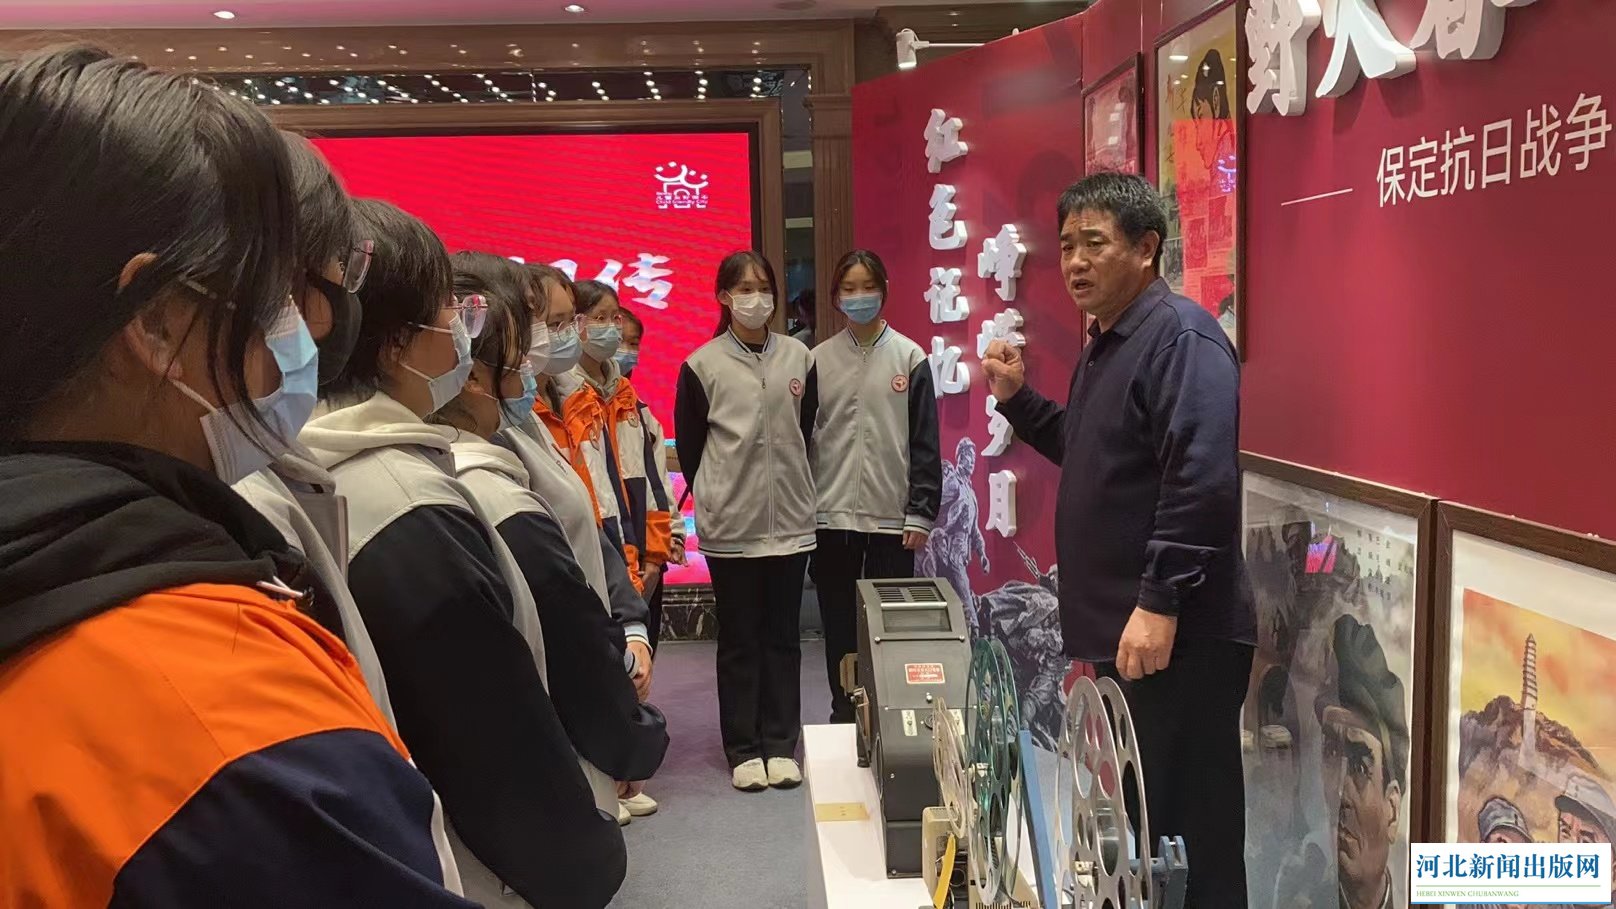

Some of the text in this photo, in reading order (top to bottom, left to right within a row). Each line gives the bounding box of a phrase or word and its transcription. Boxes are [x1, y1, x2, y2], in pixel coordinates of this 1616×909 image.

[1376, 92, 1613, 208] 保定抗日战争
[923, 108, 970, 400] 红色记忆
